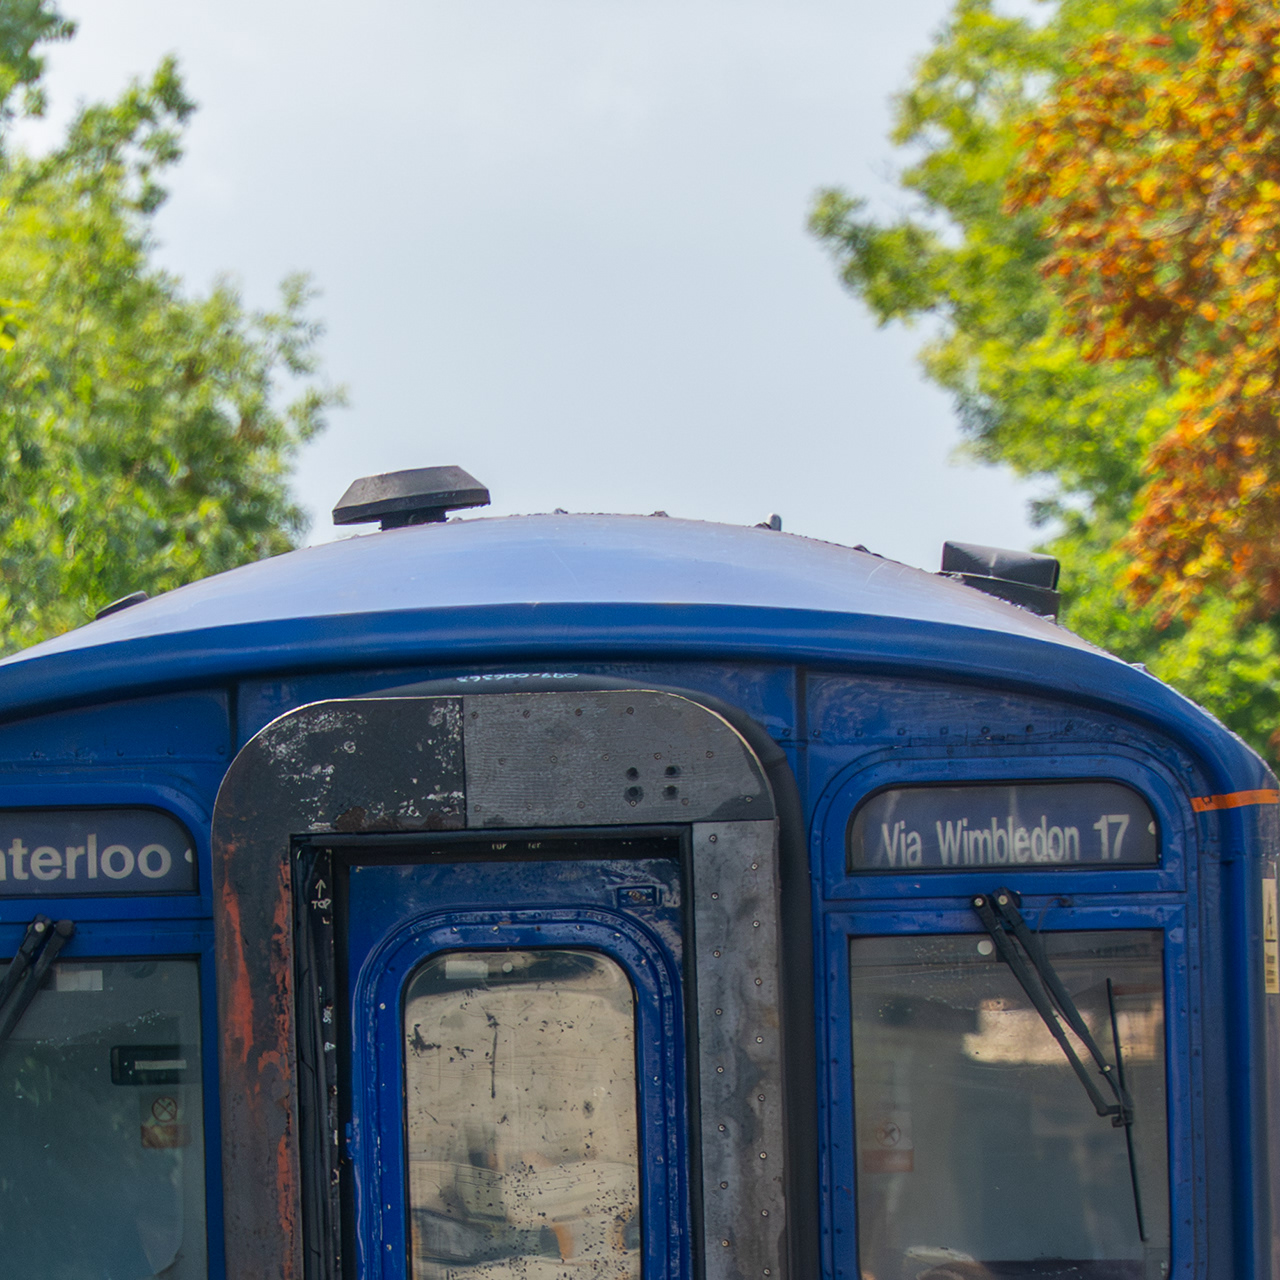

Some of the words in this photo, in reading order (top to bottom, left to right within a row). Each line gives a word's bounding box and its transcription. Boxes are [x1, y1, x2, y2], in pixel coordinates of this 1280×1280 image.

[881, 819, 922, 867] Via
[935, 814, 1080, 866] Wimbledon
[1093, 813, 1130, 860] 17
